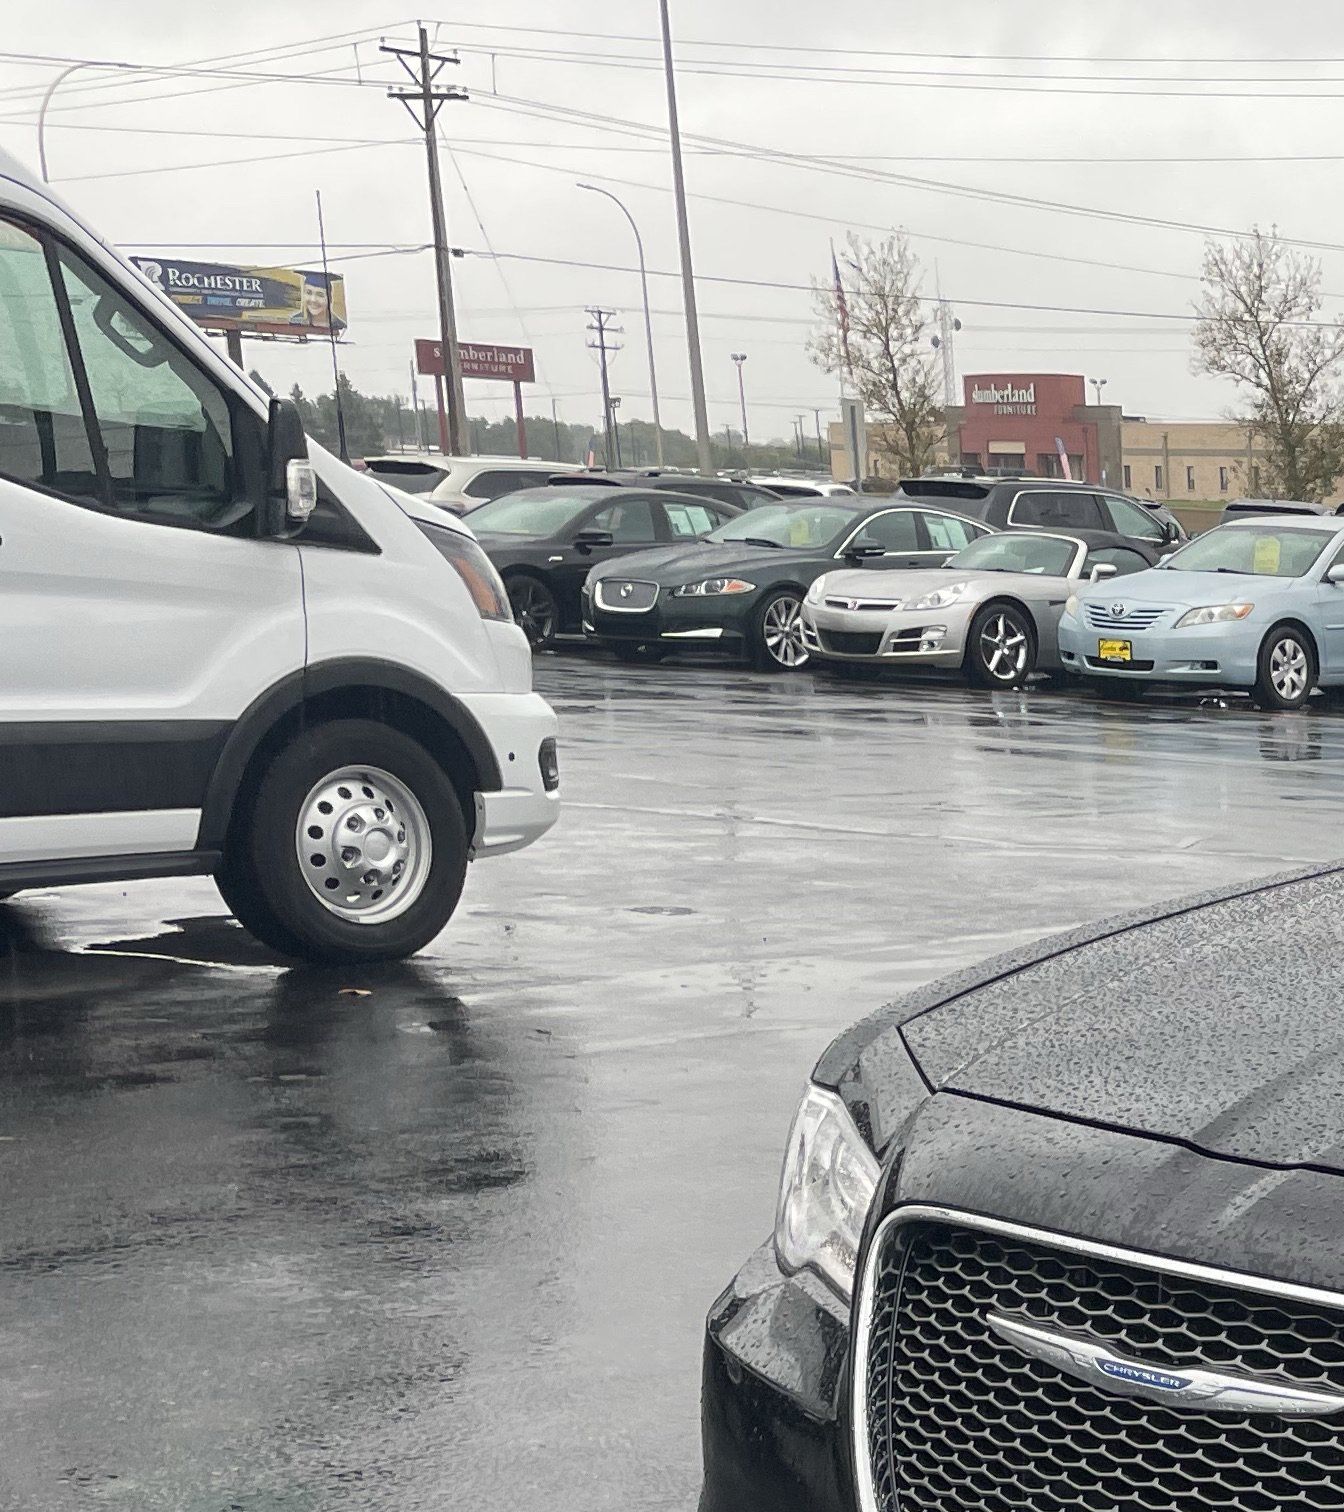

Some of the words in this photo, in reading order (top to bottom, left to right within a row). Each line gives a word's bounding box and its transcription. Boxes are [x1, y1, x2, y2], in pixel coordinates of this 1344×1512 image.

[167, 268, 263, 292] ROCHESTER
[433, 346, 525, 364] smberland
[1103, 1363, 1181, 1388] CHRYSLER
